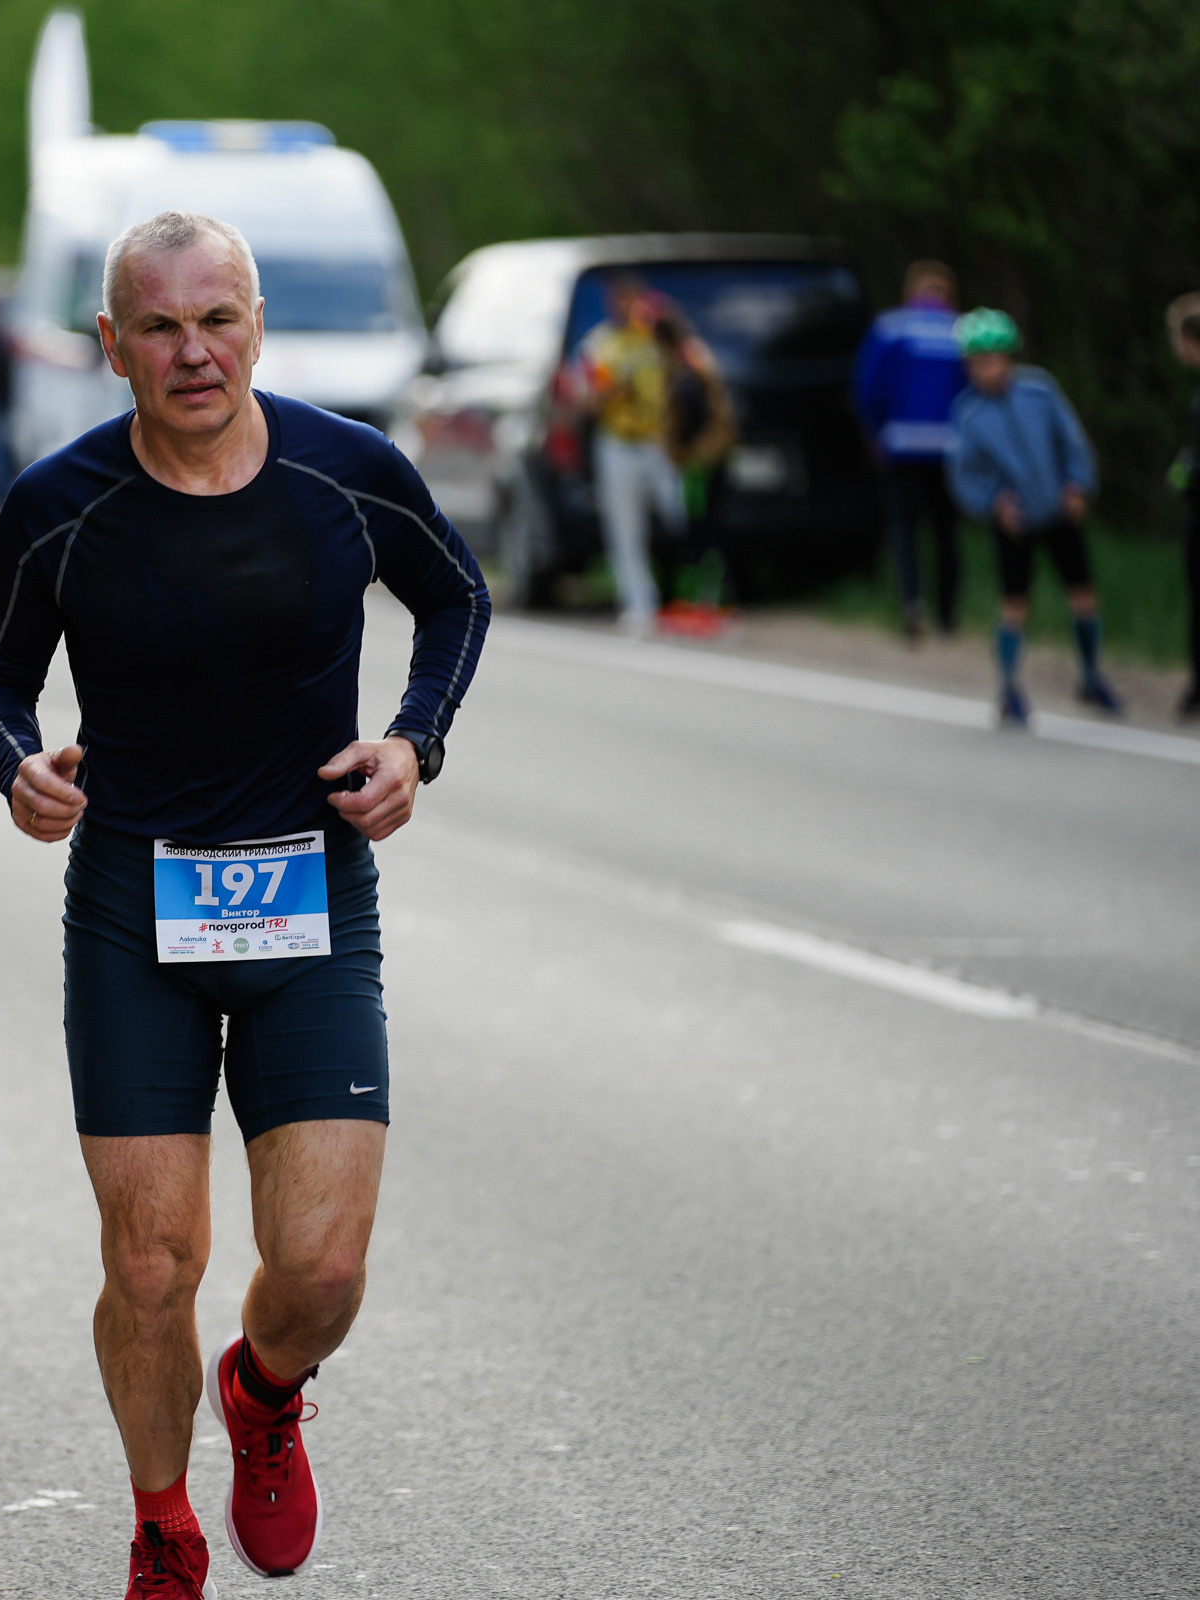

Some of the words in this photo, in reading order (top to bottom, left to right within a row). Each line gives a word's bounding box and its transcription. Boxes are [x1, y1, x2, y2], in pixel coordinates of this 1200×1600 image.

[243, 845, 290, 856] ТРИАТЛОН
[292, 842, 312, 852] 2023
[194, 860, 288, 906] 197
[221, 908, 260, 918] Виктор
